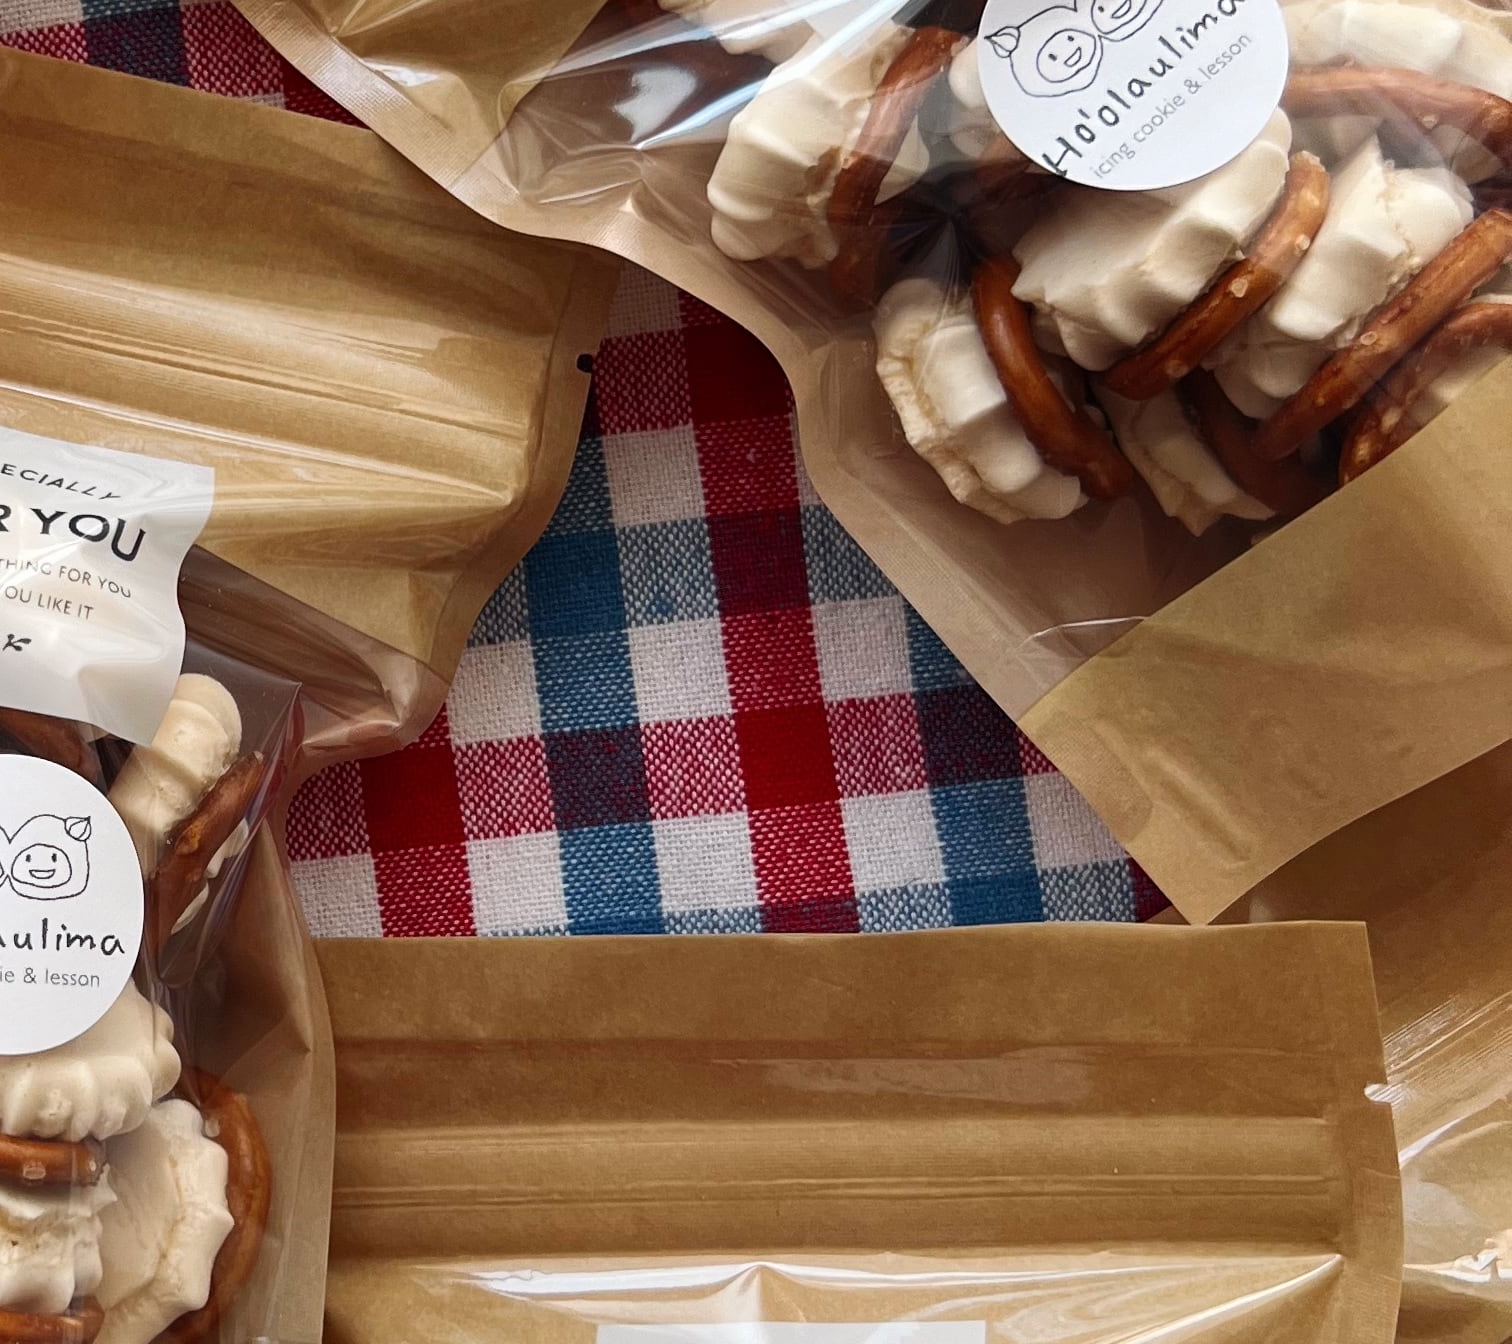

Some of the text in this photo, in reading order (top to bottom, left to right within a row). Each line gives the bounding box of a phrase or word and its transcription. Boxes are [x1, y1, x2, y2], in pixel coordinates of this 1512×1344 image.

[1093, 34, 1252, 179] icing cookie & lesson
[30, 508, 146, 561] YOU
[59, 566, 91, 586] FOR
[98, 578, 131, 598] YOU
[38, 594, 70, 615] LIKE
[77, 603, 94, 619] IT
[24, 968, 37, 984] &
[46, 968, 100, 987] lesson
